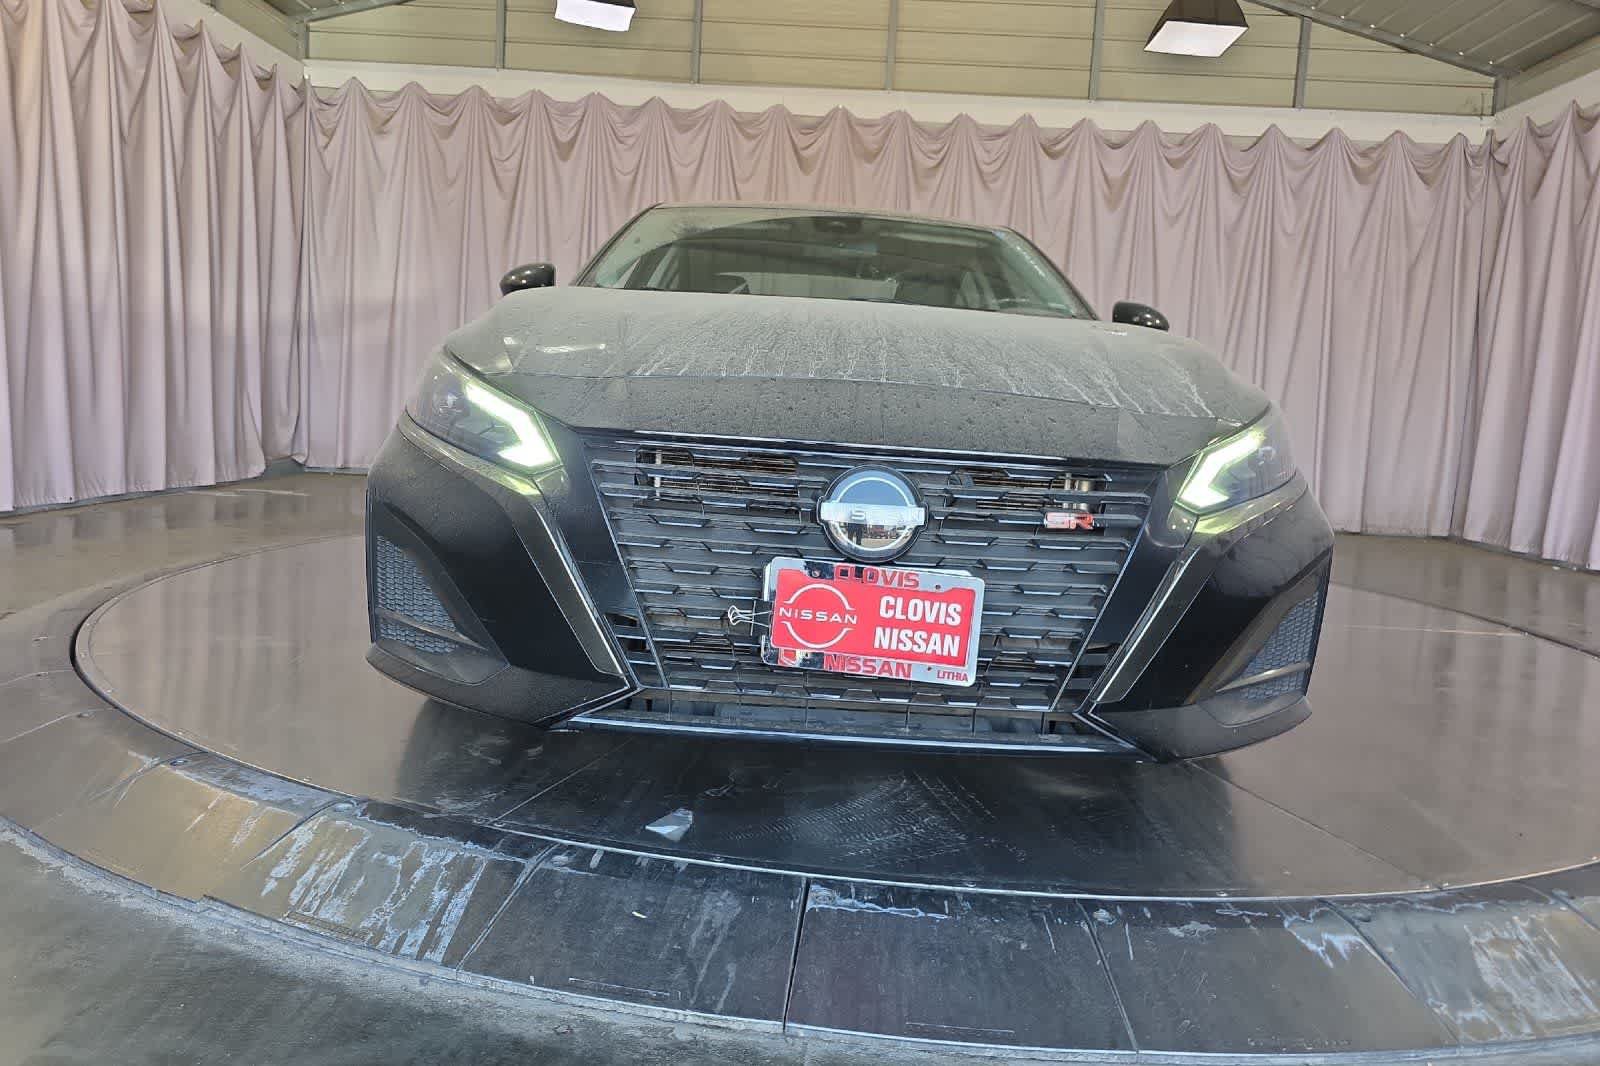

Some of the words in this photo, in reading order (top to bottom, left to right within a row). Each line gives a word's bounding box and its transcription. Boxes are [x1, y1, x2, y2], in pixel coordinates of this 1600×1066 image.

[833, 564, 920, 588] CLOVIS
[779, 606, 858, 625] NISSAN
[879, 595, 962, 625] CLOVIS
[873, 627, 961, 657] NISSAN
[823, 654, 913, 679] NISSAN
